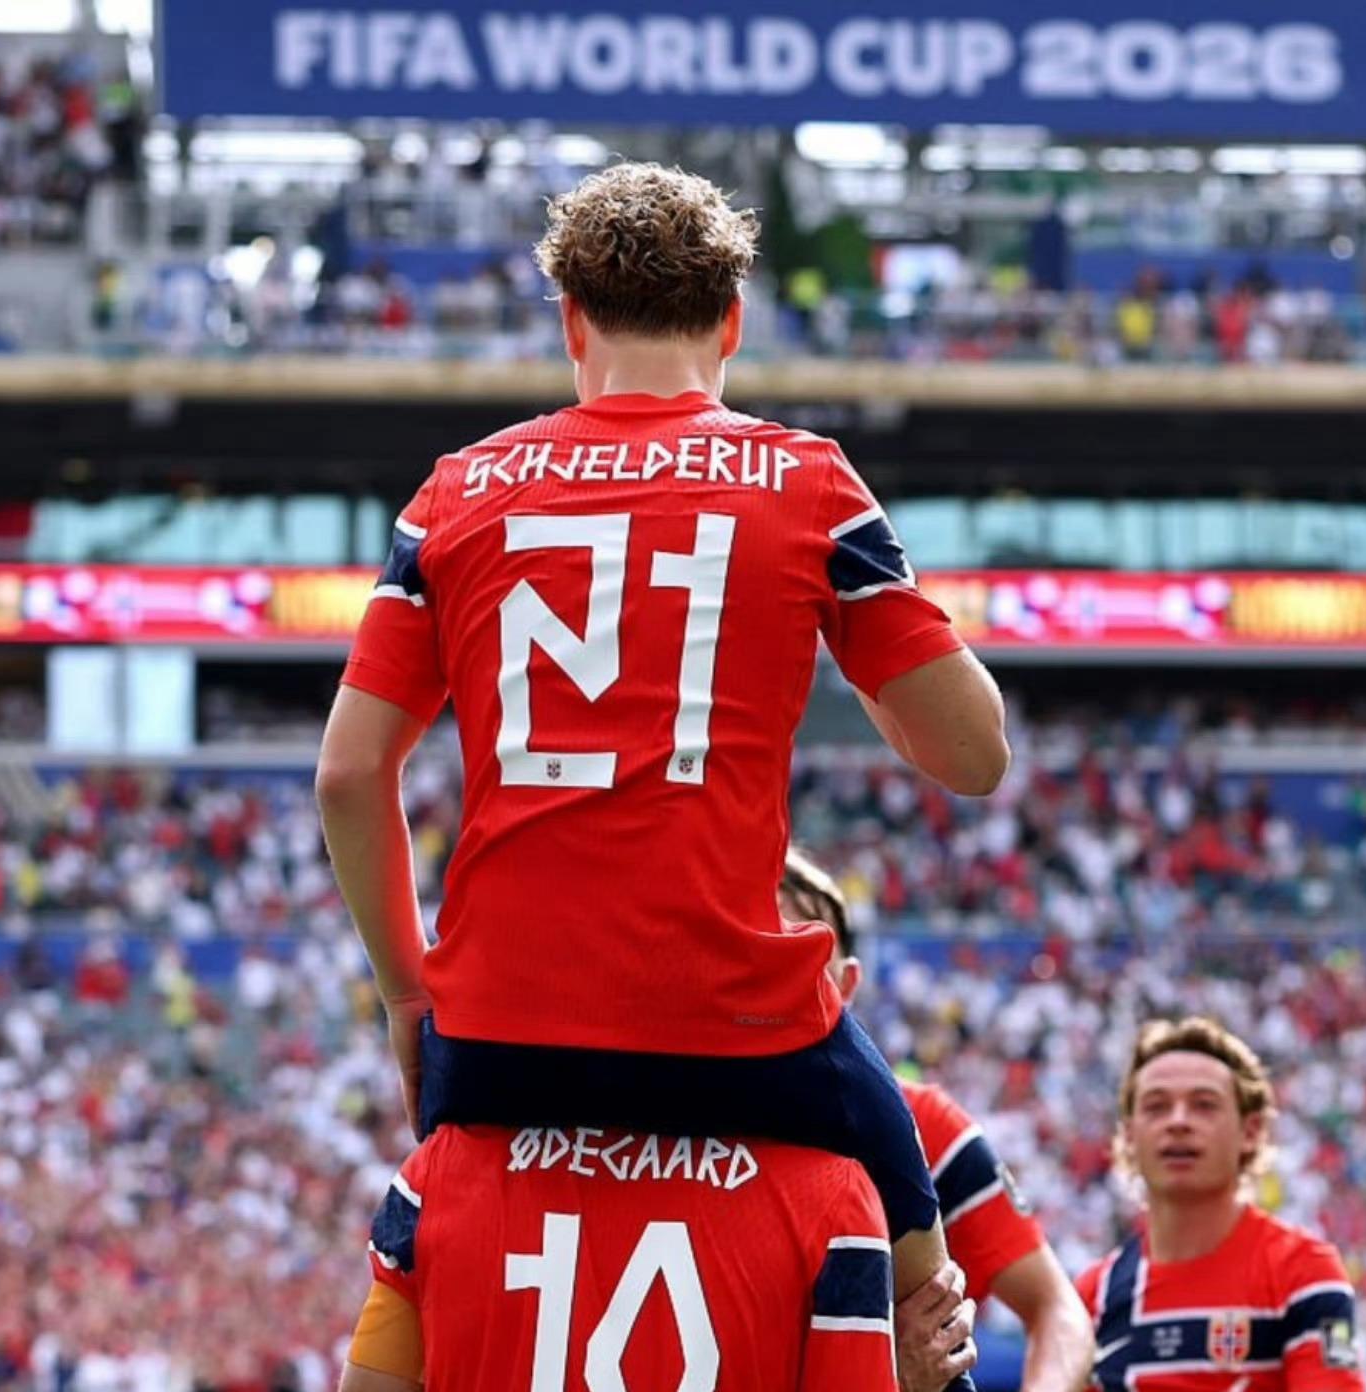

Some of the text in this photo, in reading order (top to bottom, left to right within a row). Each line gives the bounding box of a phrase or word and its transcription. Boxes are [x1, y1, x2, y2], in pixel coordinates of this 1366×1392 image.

[275, 10, 1343, 102] FIFA WORLD CUP 2026
[462, 436, 801, 499] SCHJELDERUP
[496, 512, 737, 789] 21
[506, 1126, 759, 1190] ØDEGAARD
